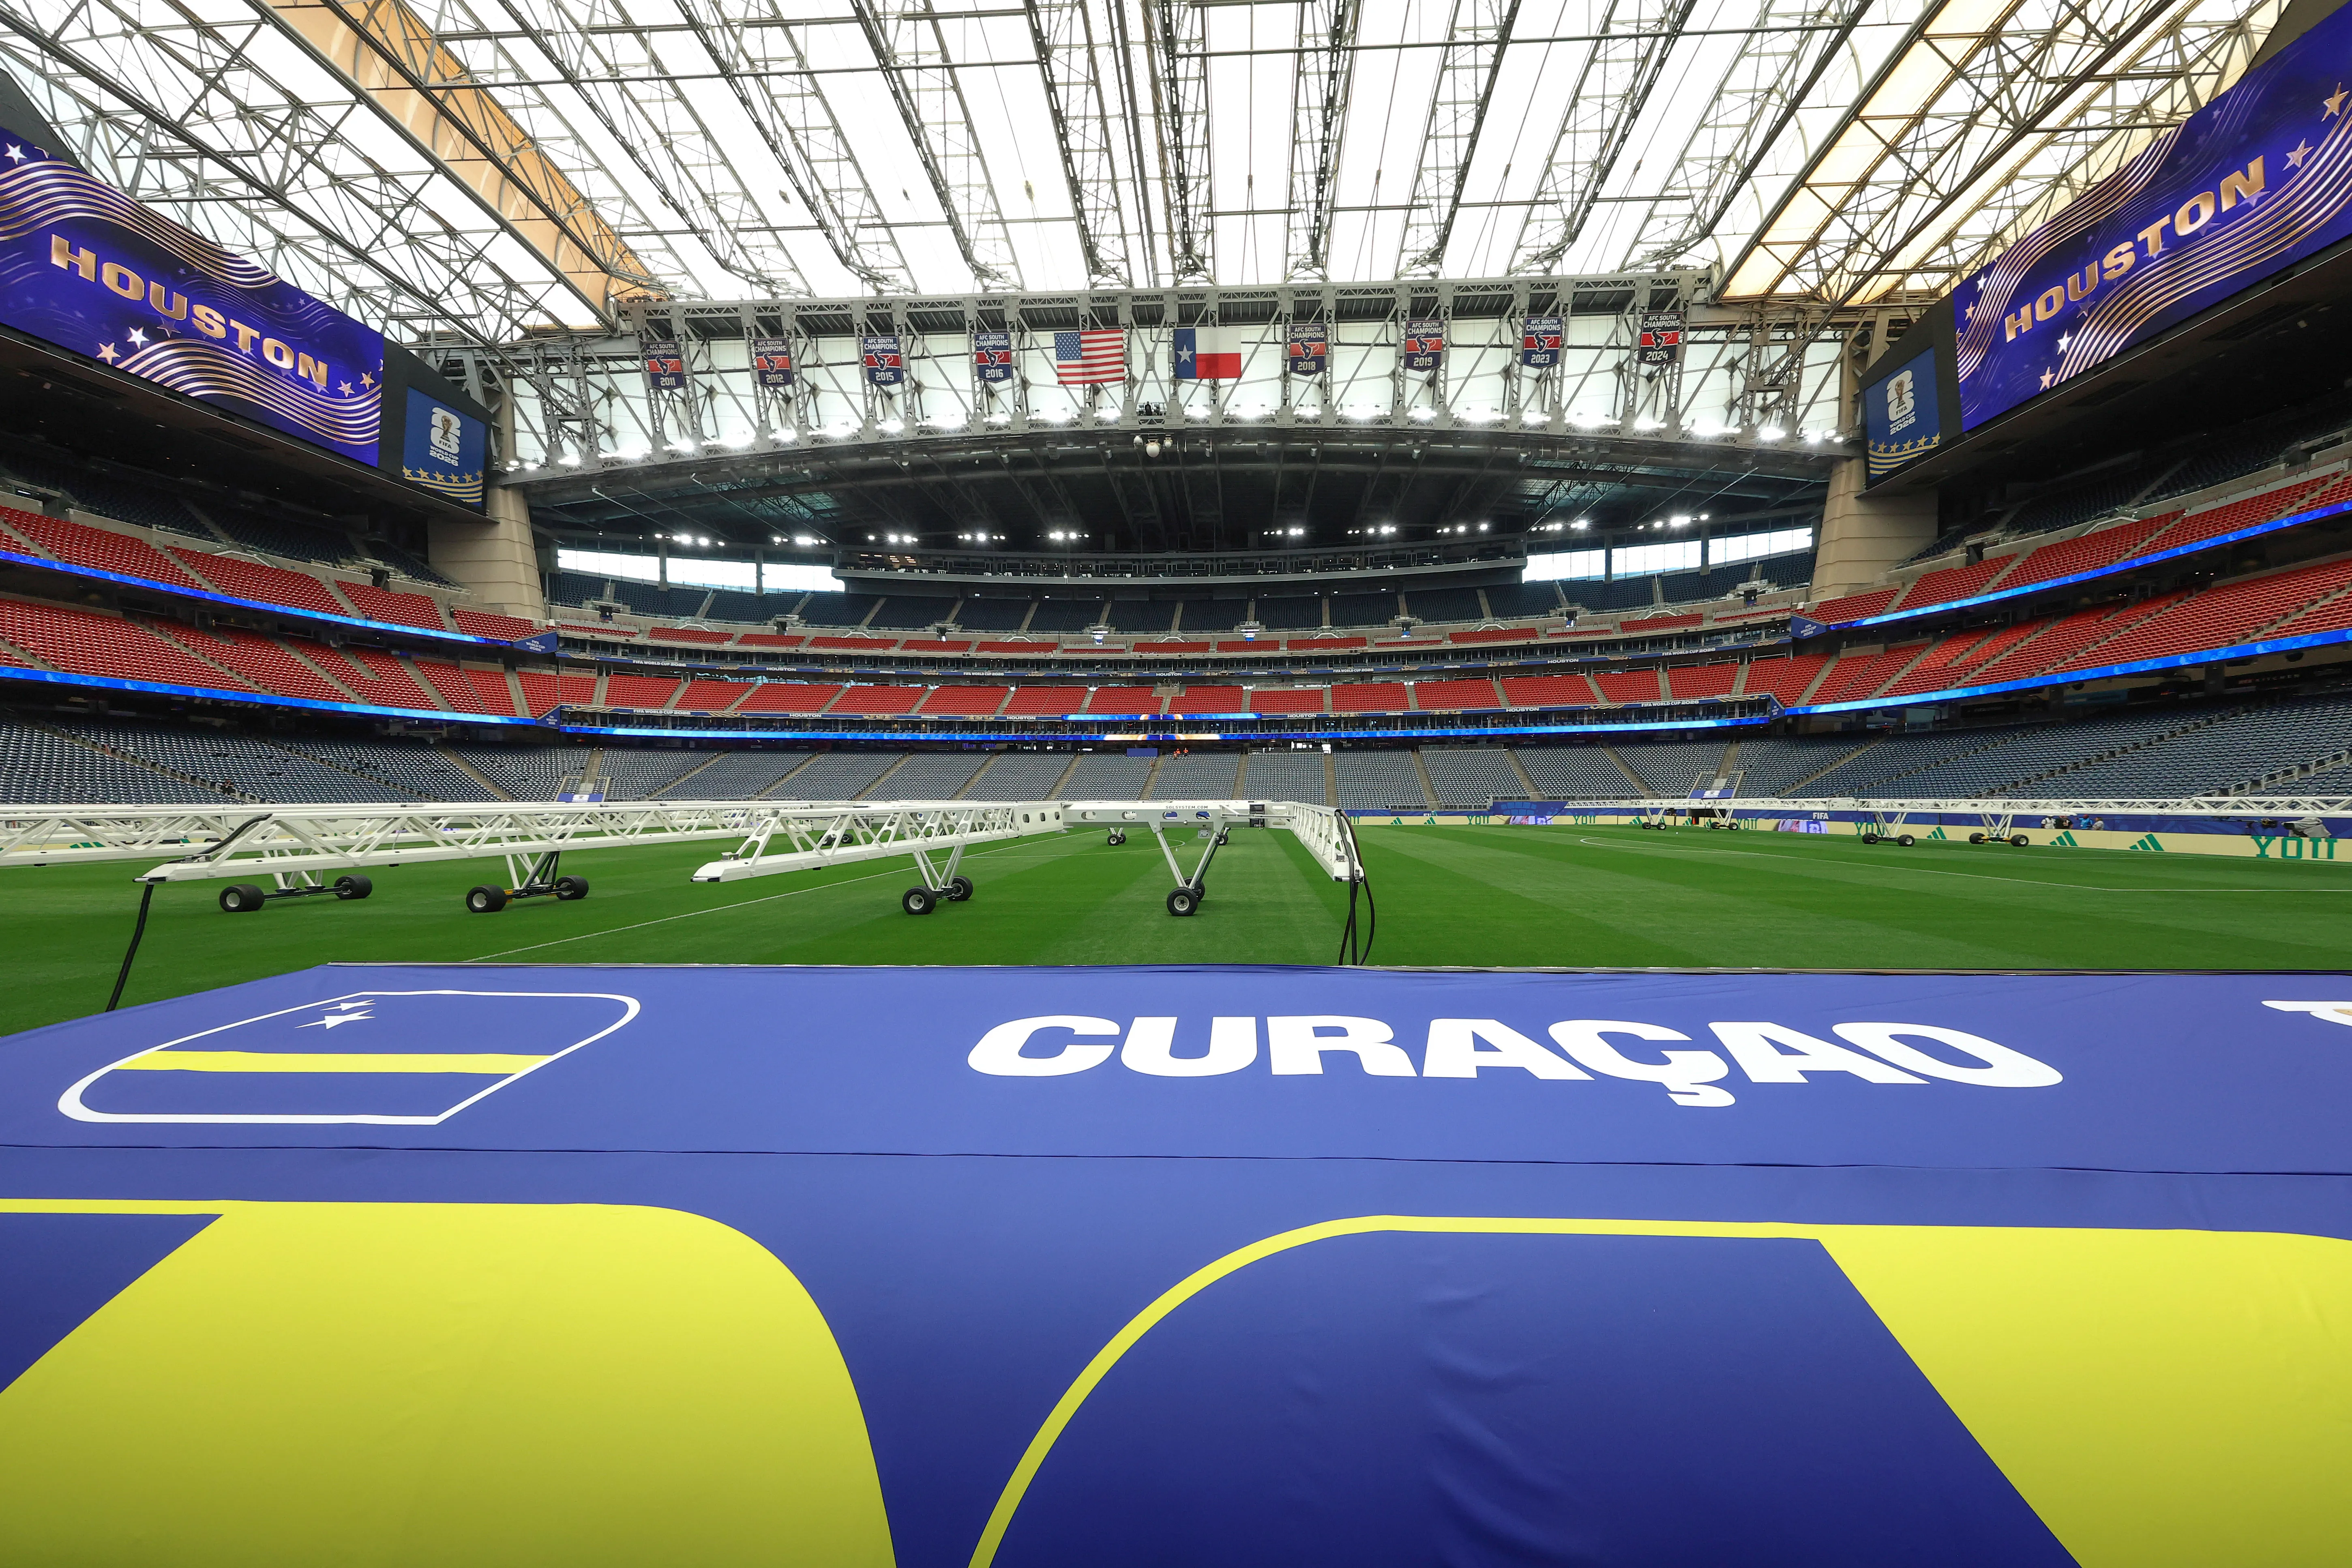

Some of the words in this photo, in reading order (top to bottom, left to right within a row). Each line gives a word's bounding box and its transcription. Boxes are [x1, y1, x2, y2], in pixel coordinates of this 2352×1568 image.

[2005, 155, 2265, 343] HOUSTON
[51, 234, 328, 387] HOUSTON
[1644, 320, 1680, 328] CHAMPIONS
[1531, 354, 1550, 363] 2023
[1646, 351, 1668, 361] 2024
[1297, 361, 1316, 371] 2018
[1413, 357, 1433, 367] 2019
[875, 372, 894, 381] 2015
[985, 369, 1003, 378] 2016
[660, 377, 676, 386] 2011
[766, 374, 785, 384] 2012
[1896, 406, 1907, 415] FIFA
[1890, 417, 1906, 428] WORLD
[1906, 412, 1915, 420] CUP
[1890, 416, 1916, 435] 2026
[439, 440, 452, 449] FIFA
[430, 445, 448, 456] WORLD
[429, 450, 459, 466] 2026
[967, 1015, 2063, 1107] CURAÇAO
